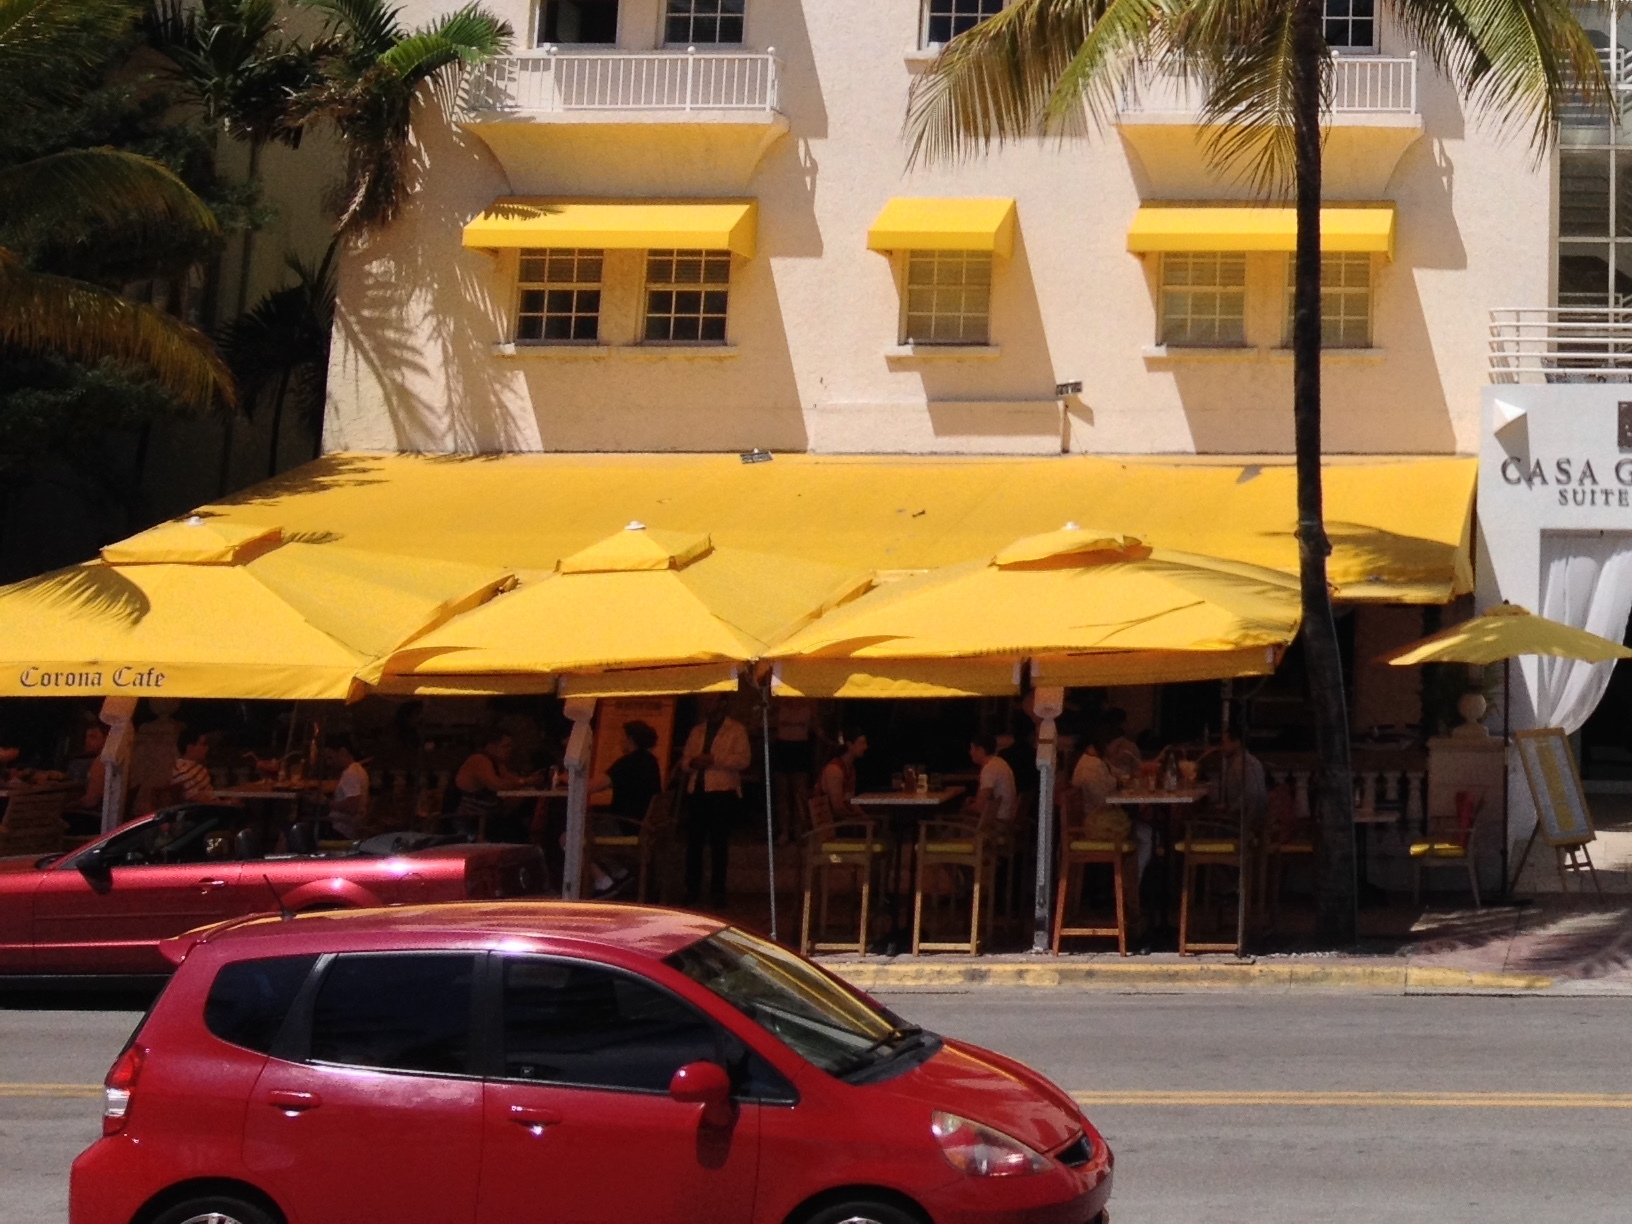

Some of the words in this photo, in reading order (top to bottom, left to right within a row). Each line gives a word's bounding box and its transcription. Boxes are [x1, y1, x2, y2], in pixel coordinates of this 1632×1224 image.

[1501, 456, 1599, 487] CASA
[1558, 488, 1630, 508] SUITE
[20, 666, 102, 688] Corona
[112, 666, 166, 688] Cafe
